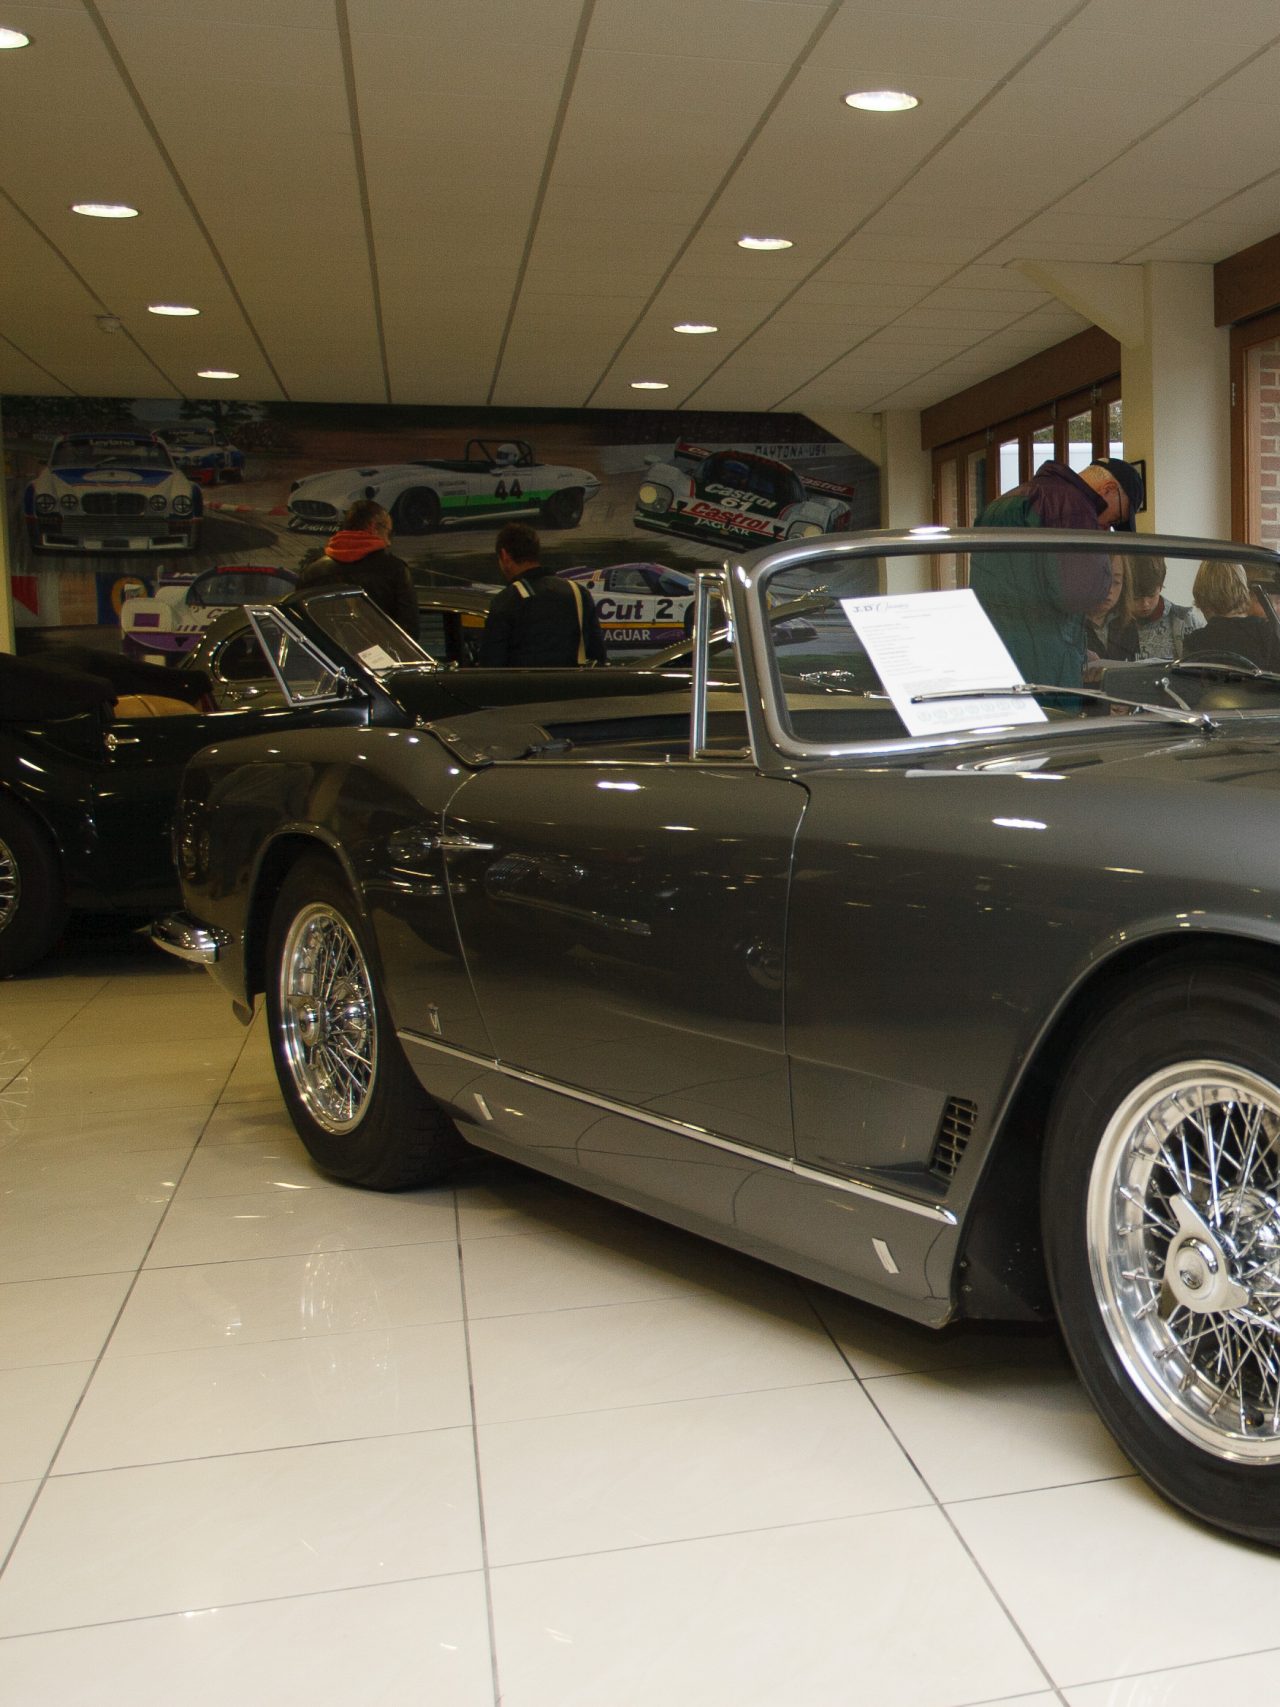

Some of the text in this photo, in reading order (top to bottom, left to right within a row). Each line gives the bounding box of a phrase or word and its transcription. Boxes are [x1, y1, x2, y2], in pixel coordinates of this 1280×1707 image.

[494, 479, 523, 500] 44
[704, 483, 778, 509] Castrol
[720, 497, 753, 511] 61
[690, 502, 771, 530] Castrol
[694, 518, 750, 536] JAGUAR
[595, 598, 674, 620] Cut 2
[603, 628, 652, 641] AGUAR
